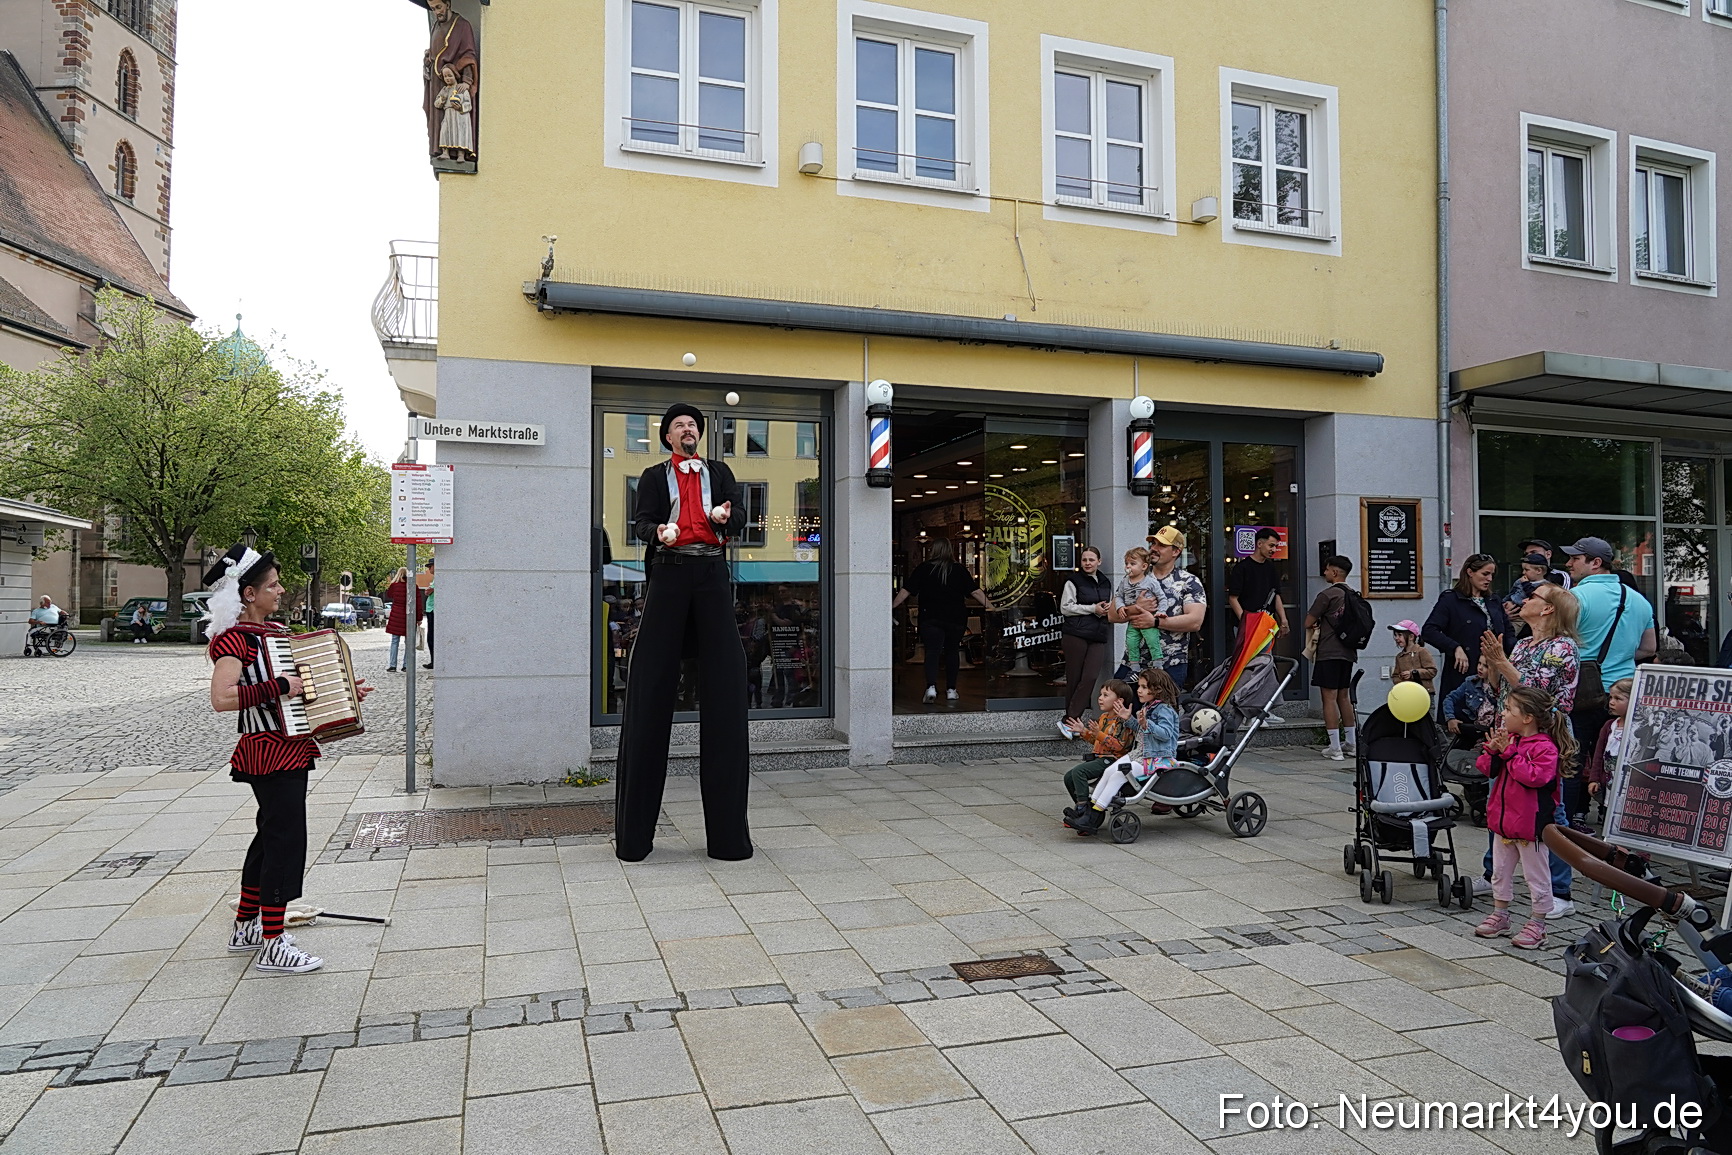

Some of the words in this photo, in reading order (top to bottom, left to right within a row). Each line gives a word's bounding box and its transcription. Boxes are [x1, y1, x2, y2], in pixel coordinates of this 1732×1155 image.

[424, 422, 462, 436] Untere
[468, 424, 539, 440] Marktstraße
[991, 510, 1016, 525] Shop
[1003, 620, 1026, 637] mit
[1015, 629, 1063, 650] Termin
[1643, 674, 1708, 702] BARBER
[1643, 697, 1672, 707] UNTERE
[1660, 764, 1678, 776] OHNE
[1678, 766, 1701, 779] TERMIN
[1626, 785, 1651, 800] BART
[1657, 790, 1688, 808] RASUR
[1706, 798, 1719, 814] 12
[1722, 801, 1732, 815] €
[1620, 815, 1650, 833] HAARE
[1657, 822, 1687, 840] RASUR
[1703, 814, 1718, 829] 20
[1700, 830, 1715, 846] 32
